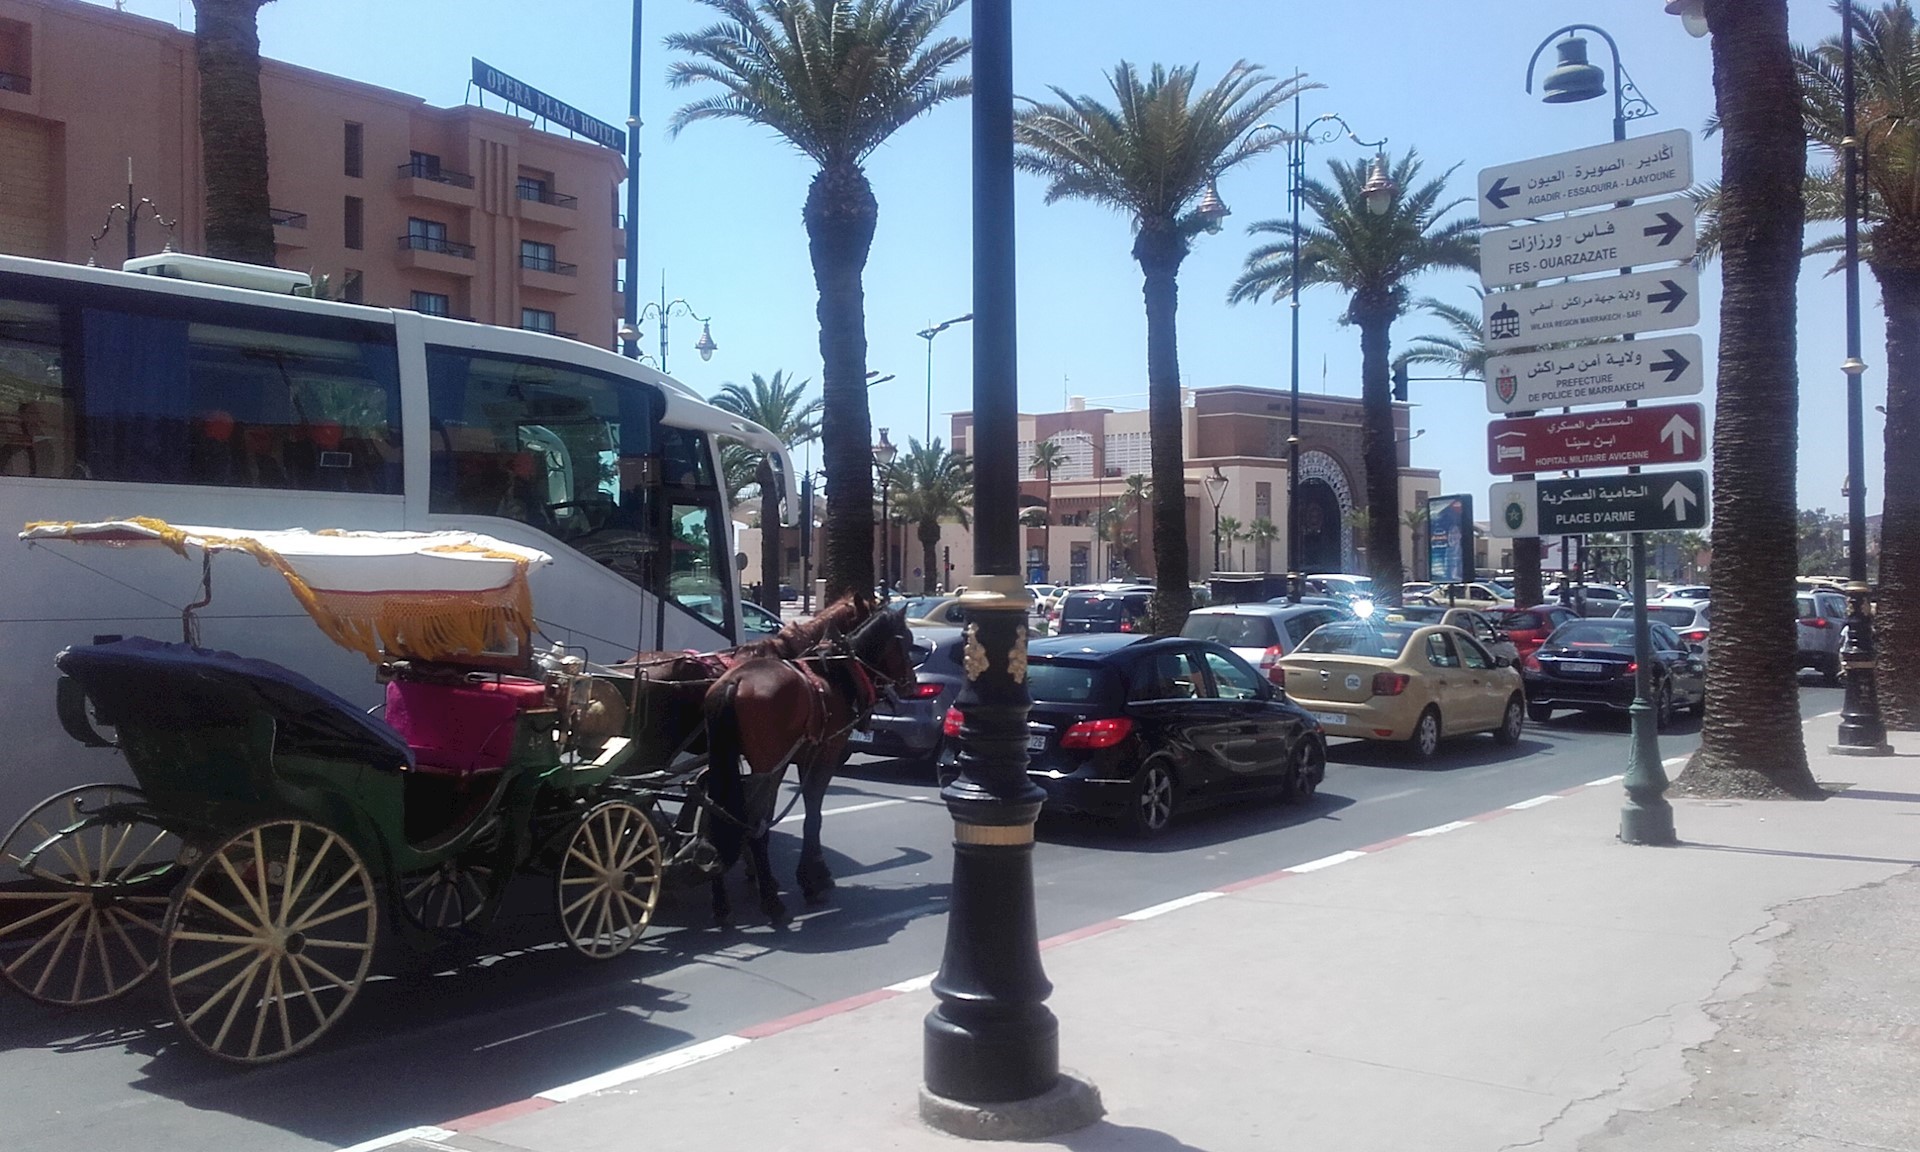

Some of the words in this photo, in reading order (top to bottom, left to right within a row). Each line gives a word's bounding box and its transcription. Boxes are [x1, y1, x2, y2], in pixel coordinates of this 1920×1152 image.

[486, 69, 532, 107] OPERA
[537, 92, 576, 128] PLAZA
[581, 113, 618, 147] HOTEL
[1575, 158, 1625, 180] الصويرة
[1527, 170, 1565, 190] العيون
[1528, 191, 1561, 205] AGADIR
[1568, 180, 1619, 198] ESSAOUIRA
[1626, 169, 1676, 187] LAAYOUNE
[1575, 221, 1615, 244] فاس
[1508, 234, 1562, 252] ورزازات
[1508, 261, 1530, 275] FES
[1540, 247, 1617, 269] OUARZAZATE
[1561, 296, 1593, 311] مراكش
[1595, 293, 1616, 304] جهة
[1619, 289, 1641, 302] ولاية
[1531, 320, 1554, 331] WILAYA
[1555, 318, 1579, 328] REGION
[1580, 312, 1621, 324] MARRAKECH
[1627, 310, 1642, 319] SAFI
[1578, 354, 1601, 372] أمن
[1606, 350, 1642, 367] ولاية
[1528, 360, 1575, 378] مراكش
[1556, 373, 1614, 388] PREFECTURE
[1528, 393, 1540, 403] DE
[1541, 389, 1573, 401] POLICE
[1574, 387, 1587, 397] DE
[1588, 381, 1645, 396] MARRAKECH
[1586, 415, 1634, 431] المستشفى
[1565, 436, 1591, 450] سينا
[1535, 456, 1568, 467] HOPITAL
[1569, 452, 1607, 464] MILITAIRE
[1608, 450, 1649, 462] AVICENNE
[1542, 489, 1597, 505] العسكرية
[1599, 486, 1648, 500] الحامية
[1556, 513, 1591, 525] PLACE
[1593, 510, 1636, 522] D'ARME
